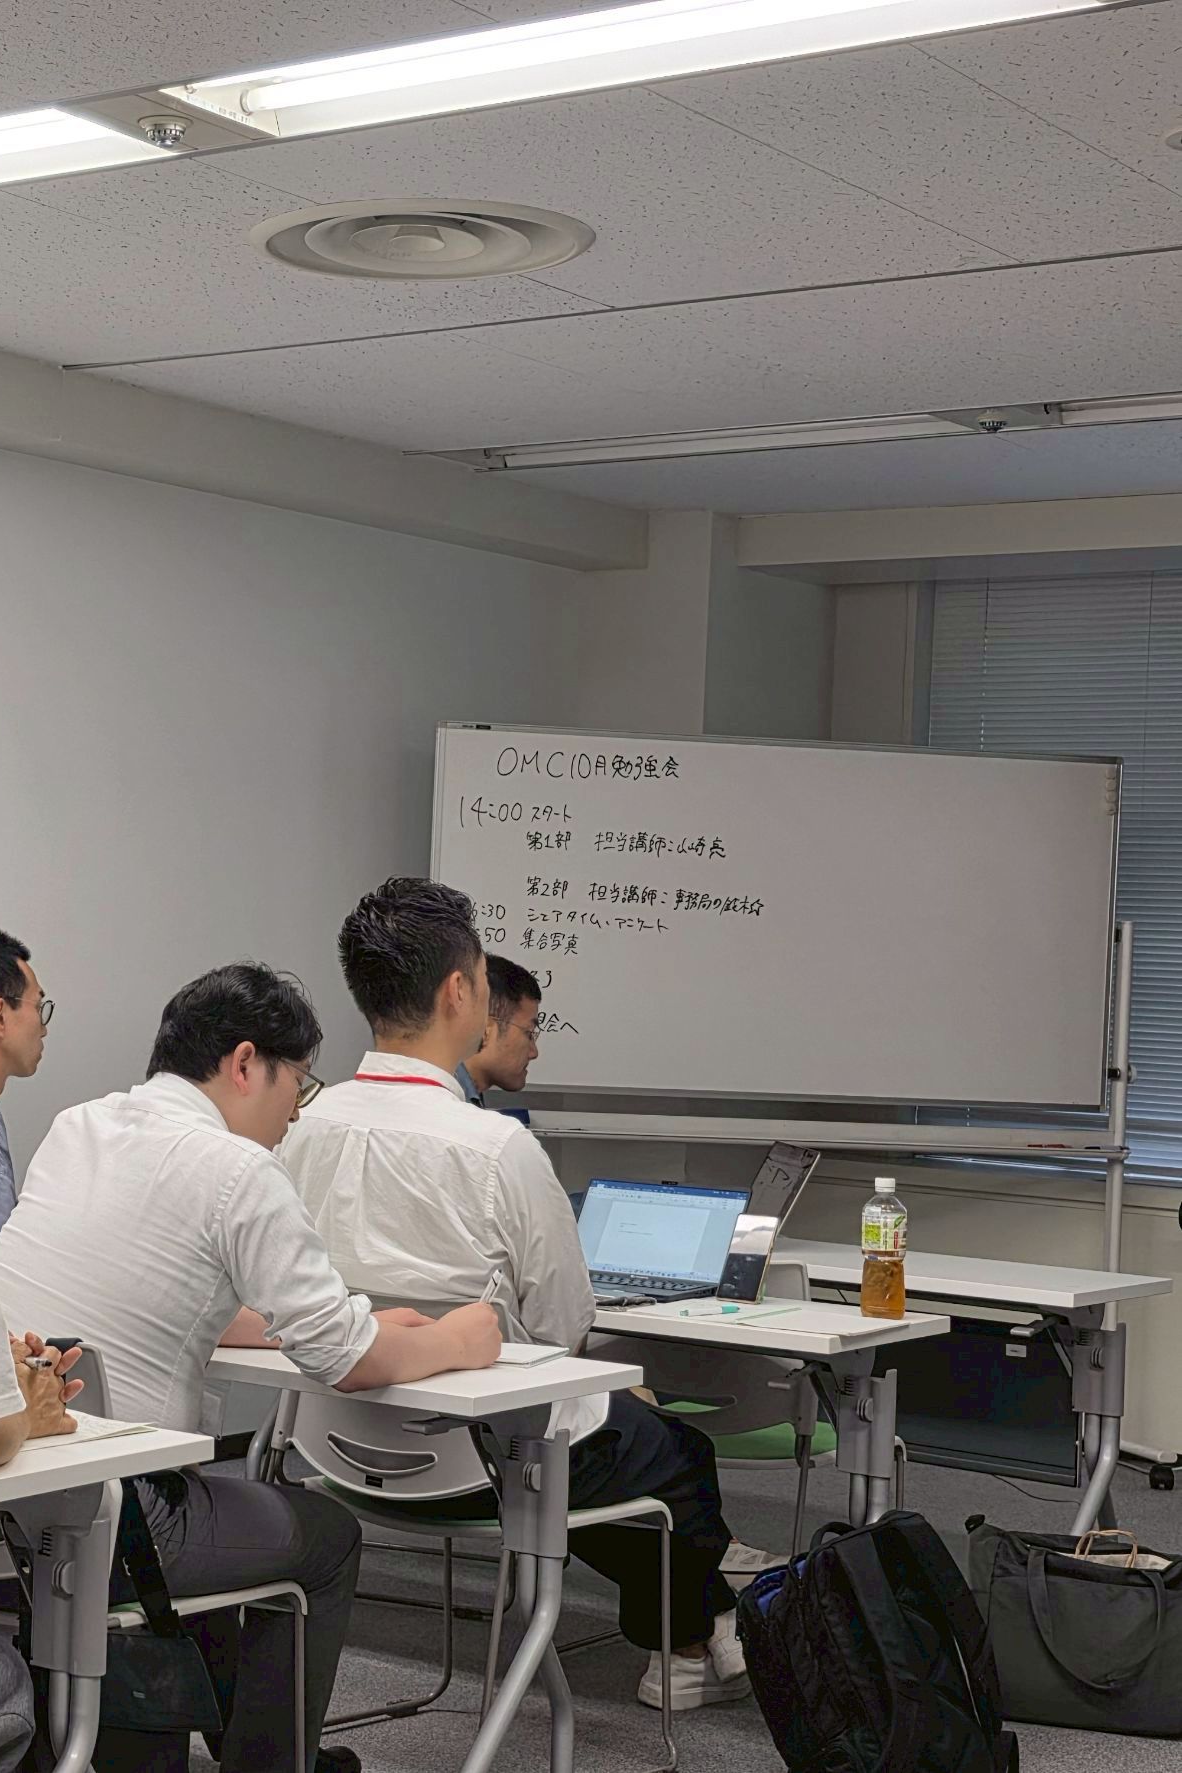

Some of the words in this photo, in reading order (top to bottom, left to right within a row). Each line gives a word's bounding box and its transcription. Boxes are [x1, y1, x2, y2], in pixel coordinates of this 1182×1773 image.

[459, 796, 522, 828] 14:00
[530, 805, 572, 822] スタート
[526, 830, 571, 851] 第1部
[527, 876, 569, 899] 第2部
[470, 902, 506, 920] 6:30
[520, 927, 579, 955] 集合写真
